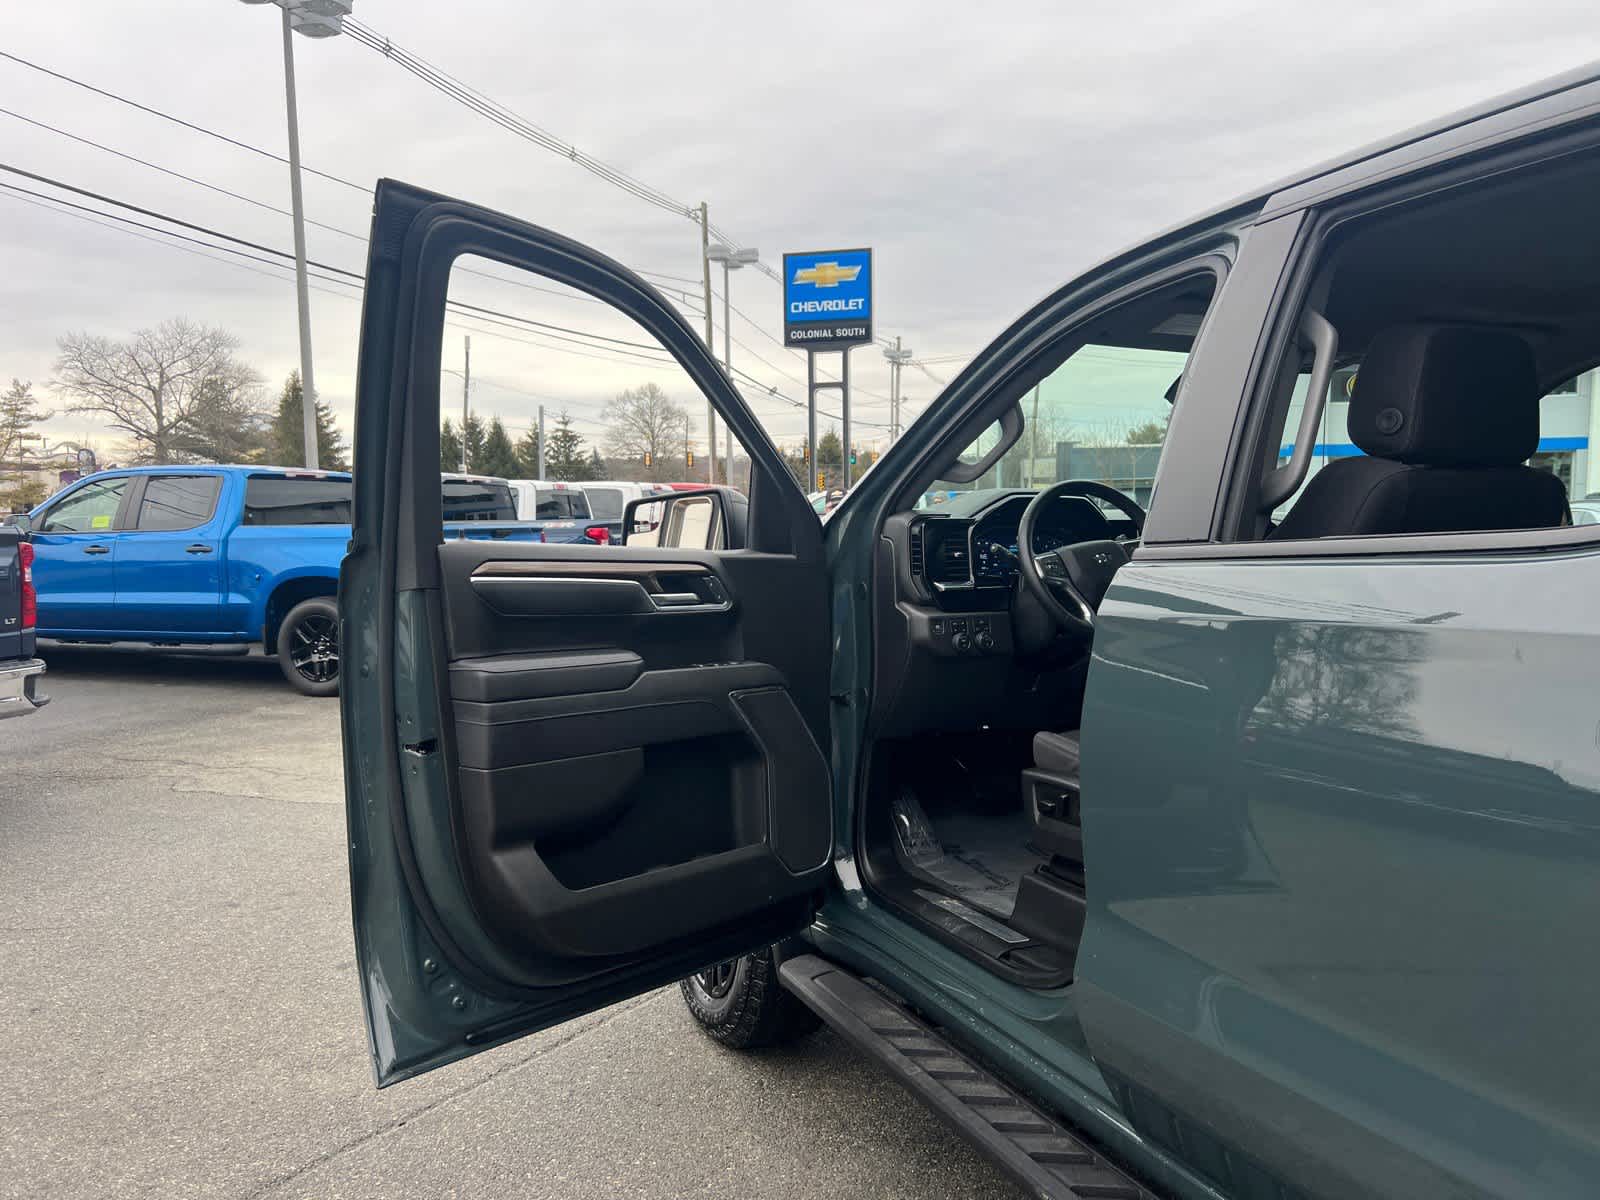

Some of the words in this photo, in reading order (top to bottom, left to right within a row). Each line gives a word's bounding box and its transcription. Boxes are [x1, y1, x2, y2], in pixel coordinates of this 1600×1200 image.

[791, 299, 864, 313] CHEVROLET
[790, 329, 833, 339] COLONIAL
[836, 328, 865, 337] SOUTH
